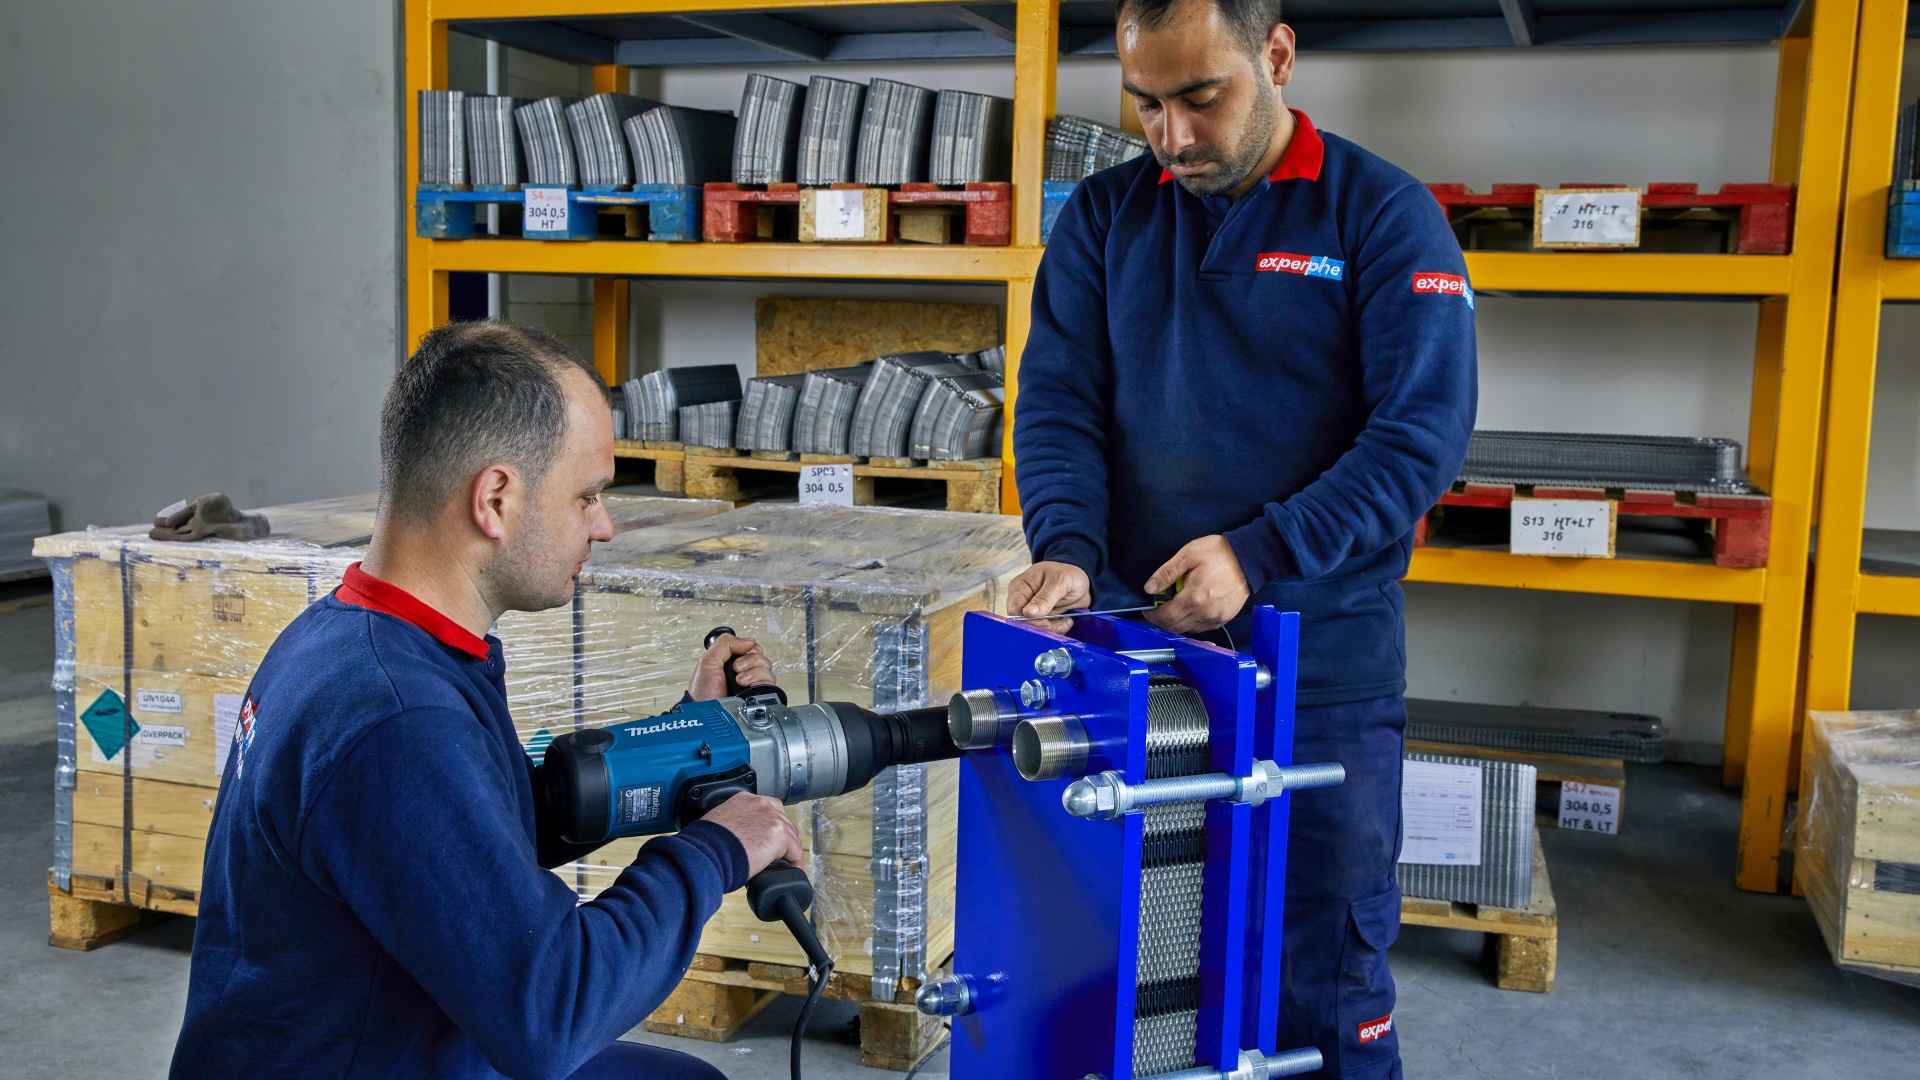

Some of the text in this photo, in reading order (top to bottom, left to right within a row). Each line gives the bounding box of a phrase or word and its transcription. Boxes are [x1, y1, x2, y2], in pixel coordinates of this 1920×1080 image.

[531, 190, 544, 200] S4
[529, 207, 566, 219] 304 0,5
[541, 219, 555, 230] HT
[1572, 219, 1594, 229] 316
[1259, 256, 1341, 276] experphe
[811, 466, 836, 477] SPC3
[805, 482, 844, 494] 304 0,5
[1522, 516, 1595, 528] S13 HT+LT
[1542, 531, 1564, 541] 316
[143, 694, 176, 703] UN1044
[142, 729, 184, 740] OVERPACK
[1564, 782, 1588, 795] S47
[1565, 800, 1612, 816] 304 0,5
[1562, 817, 1613, 832] HT & LT
